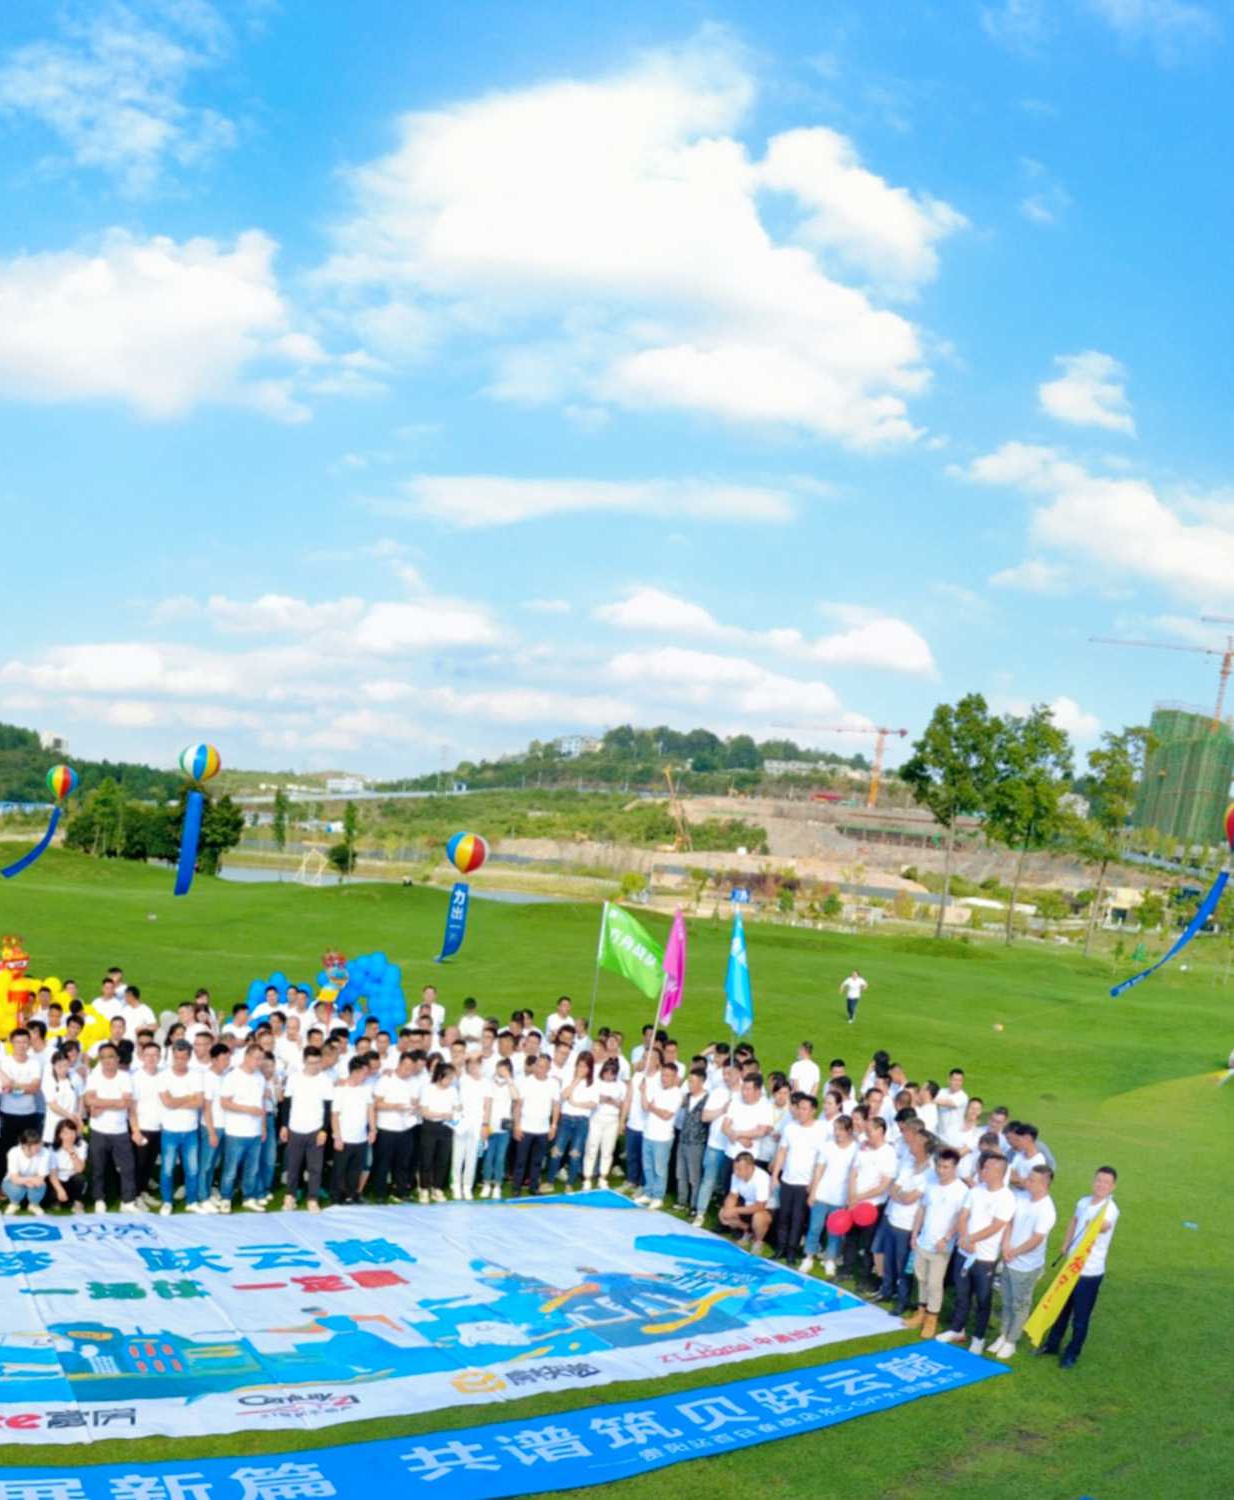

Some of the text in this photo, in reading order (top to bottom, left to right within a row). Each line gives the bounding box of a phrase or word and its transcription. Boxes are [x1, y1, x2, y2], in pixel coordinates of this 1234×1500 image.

[400, 1352, 954, 1482] 共谱筑贝跃云巅
